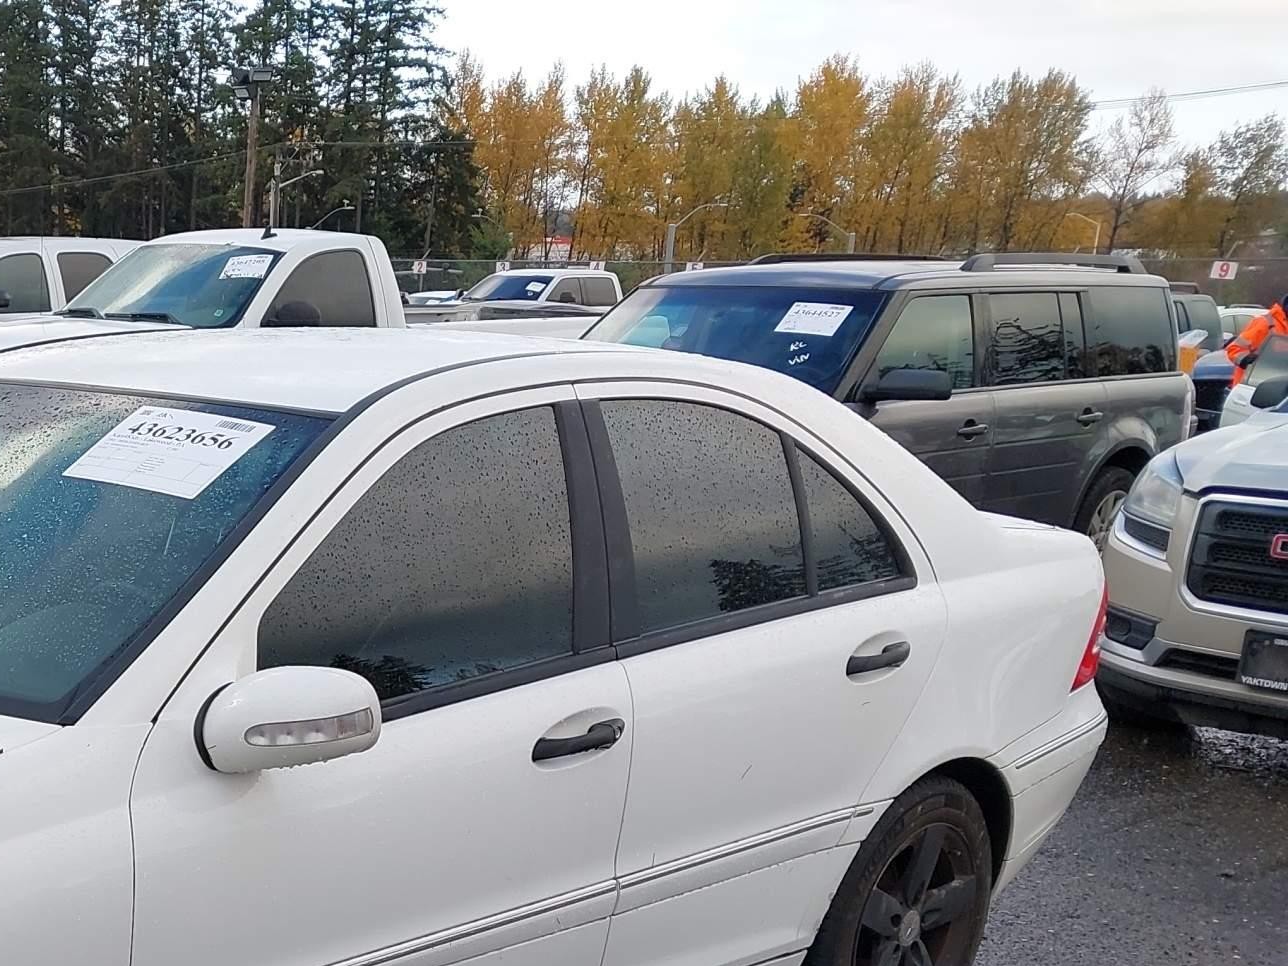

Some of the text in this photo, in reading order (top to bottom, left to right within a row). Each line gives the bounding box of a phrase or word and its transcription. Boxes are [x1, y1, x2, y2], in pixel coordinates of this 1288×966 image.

[417, 261, 423, 272] 2
[1218, 262, 1230, 278] 9
[127, 421, 240, 450] 43623656
[1241, 675, 1288, 691] YAKTOWN
